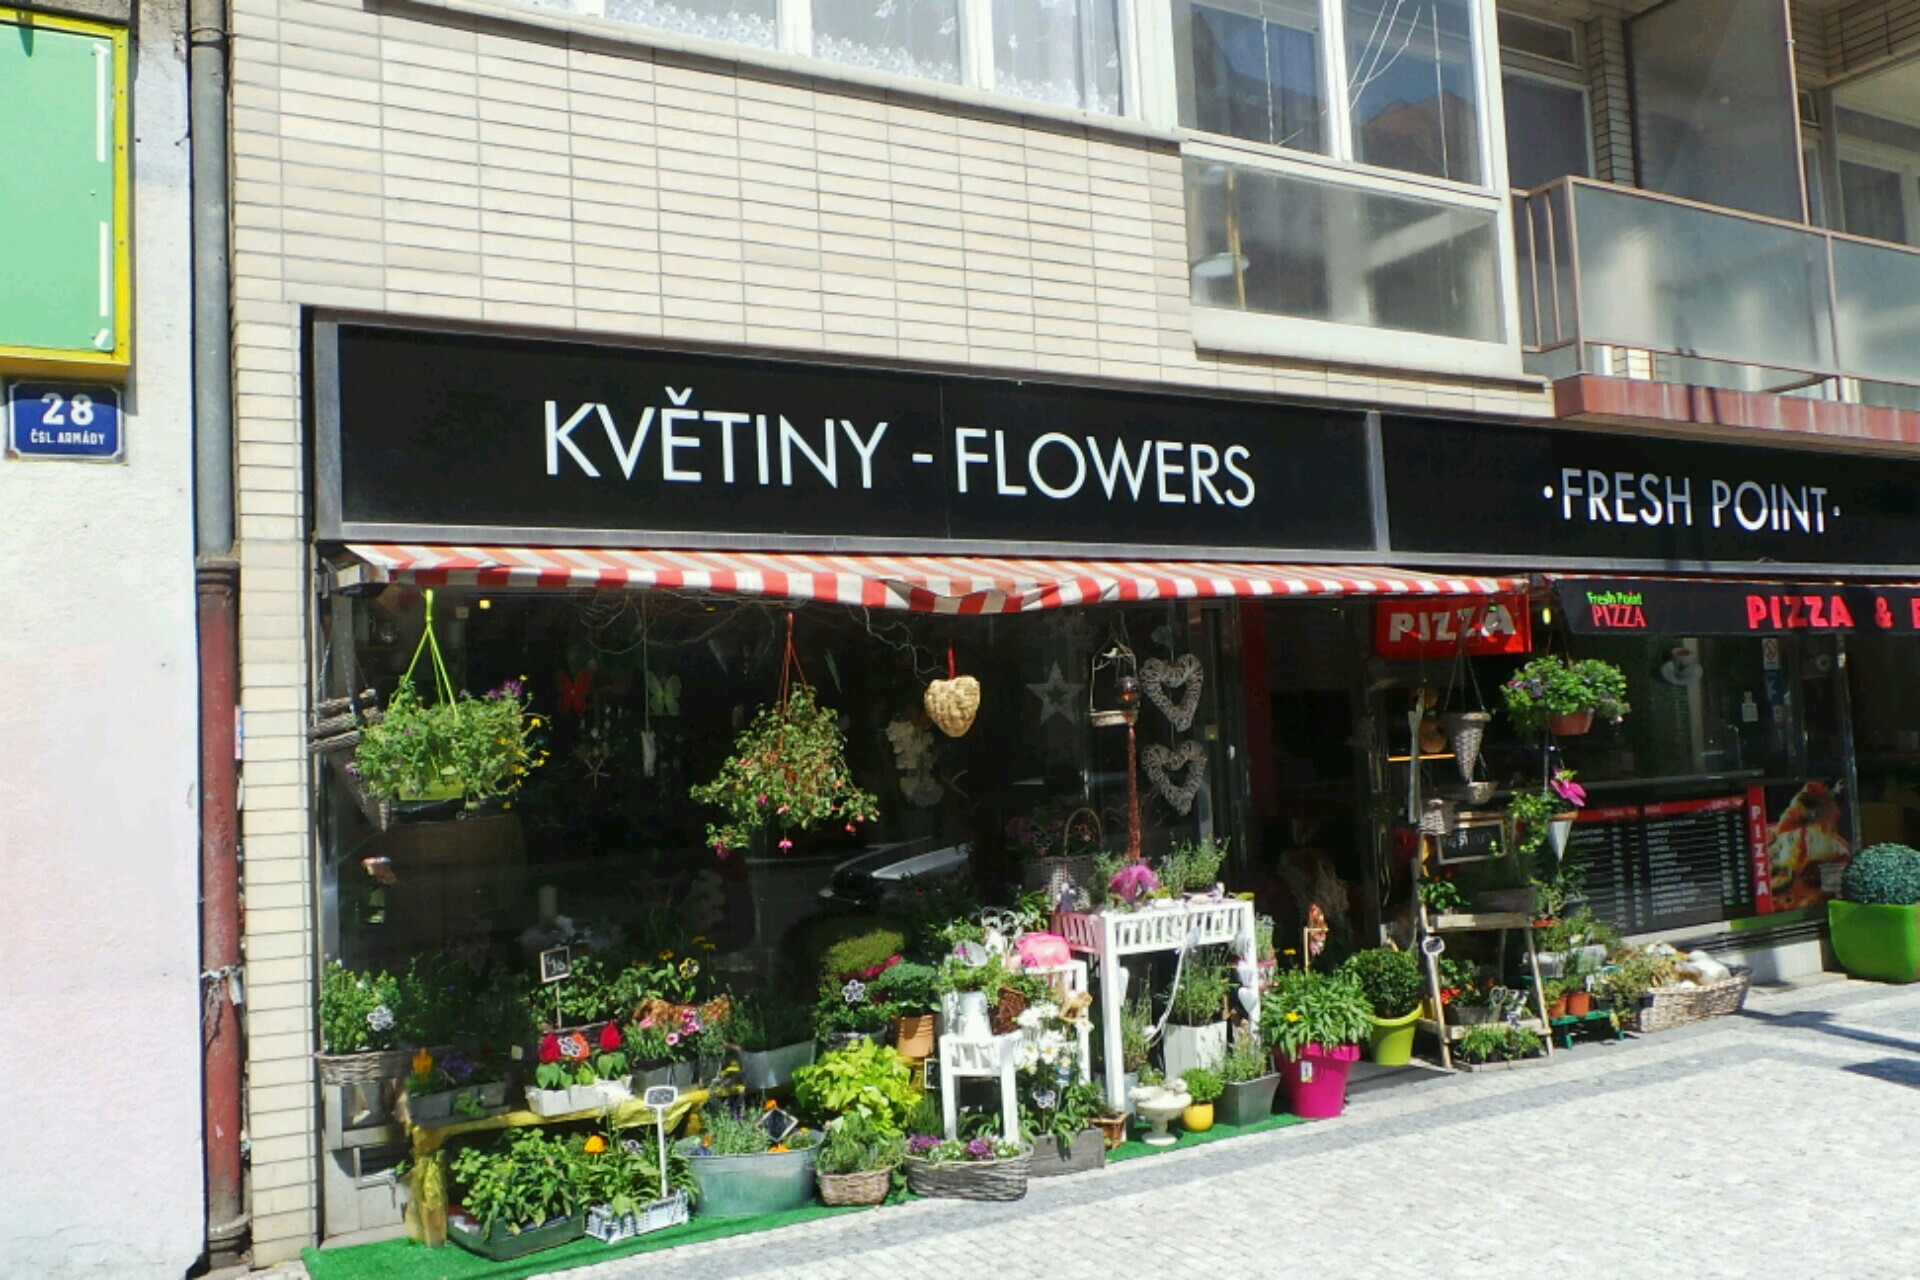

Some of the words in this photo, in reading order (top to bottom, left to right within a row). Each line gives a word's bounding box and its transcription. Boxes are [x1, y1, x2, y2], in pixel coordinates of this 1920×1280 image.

[42, 393, 94, 425] 28
[57, 431, 105, 445] ARMÁDY
[544, 386, 889, 489] KVĚTINY
[955, 427, 1256, 507] FLOWERS
[1389, 604, 1517, 641] PIZZA
[1591, 603, 1647, 628] PIZZA
[1745, 594, 1856, 630] PIZZA
[1874, 596, 1893, 629] &
[1751, 805, 1769, 895] PIZZA
